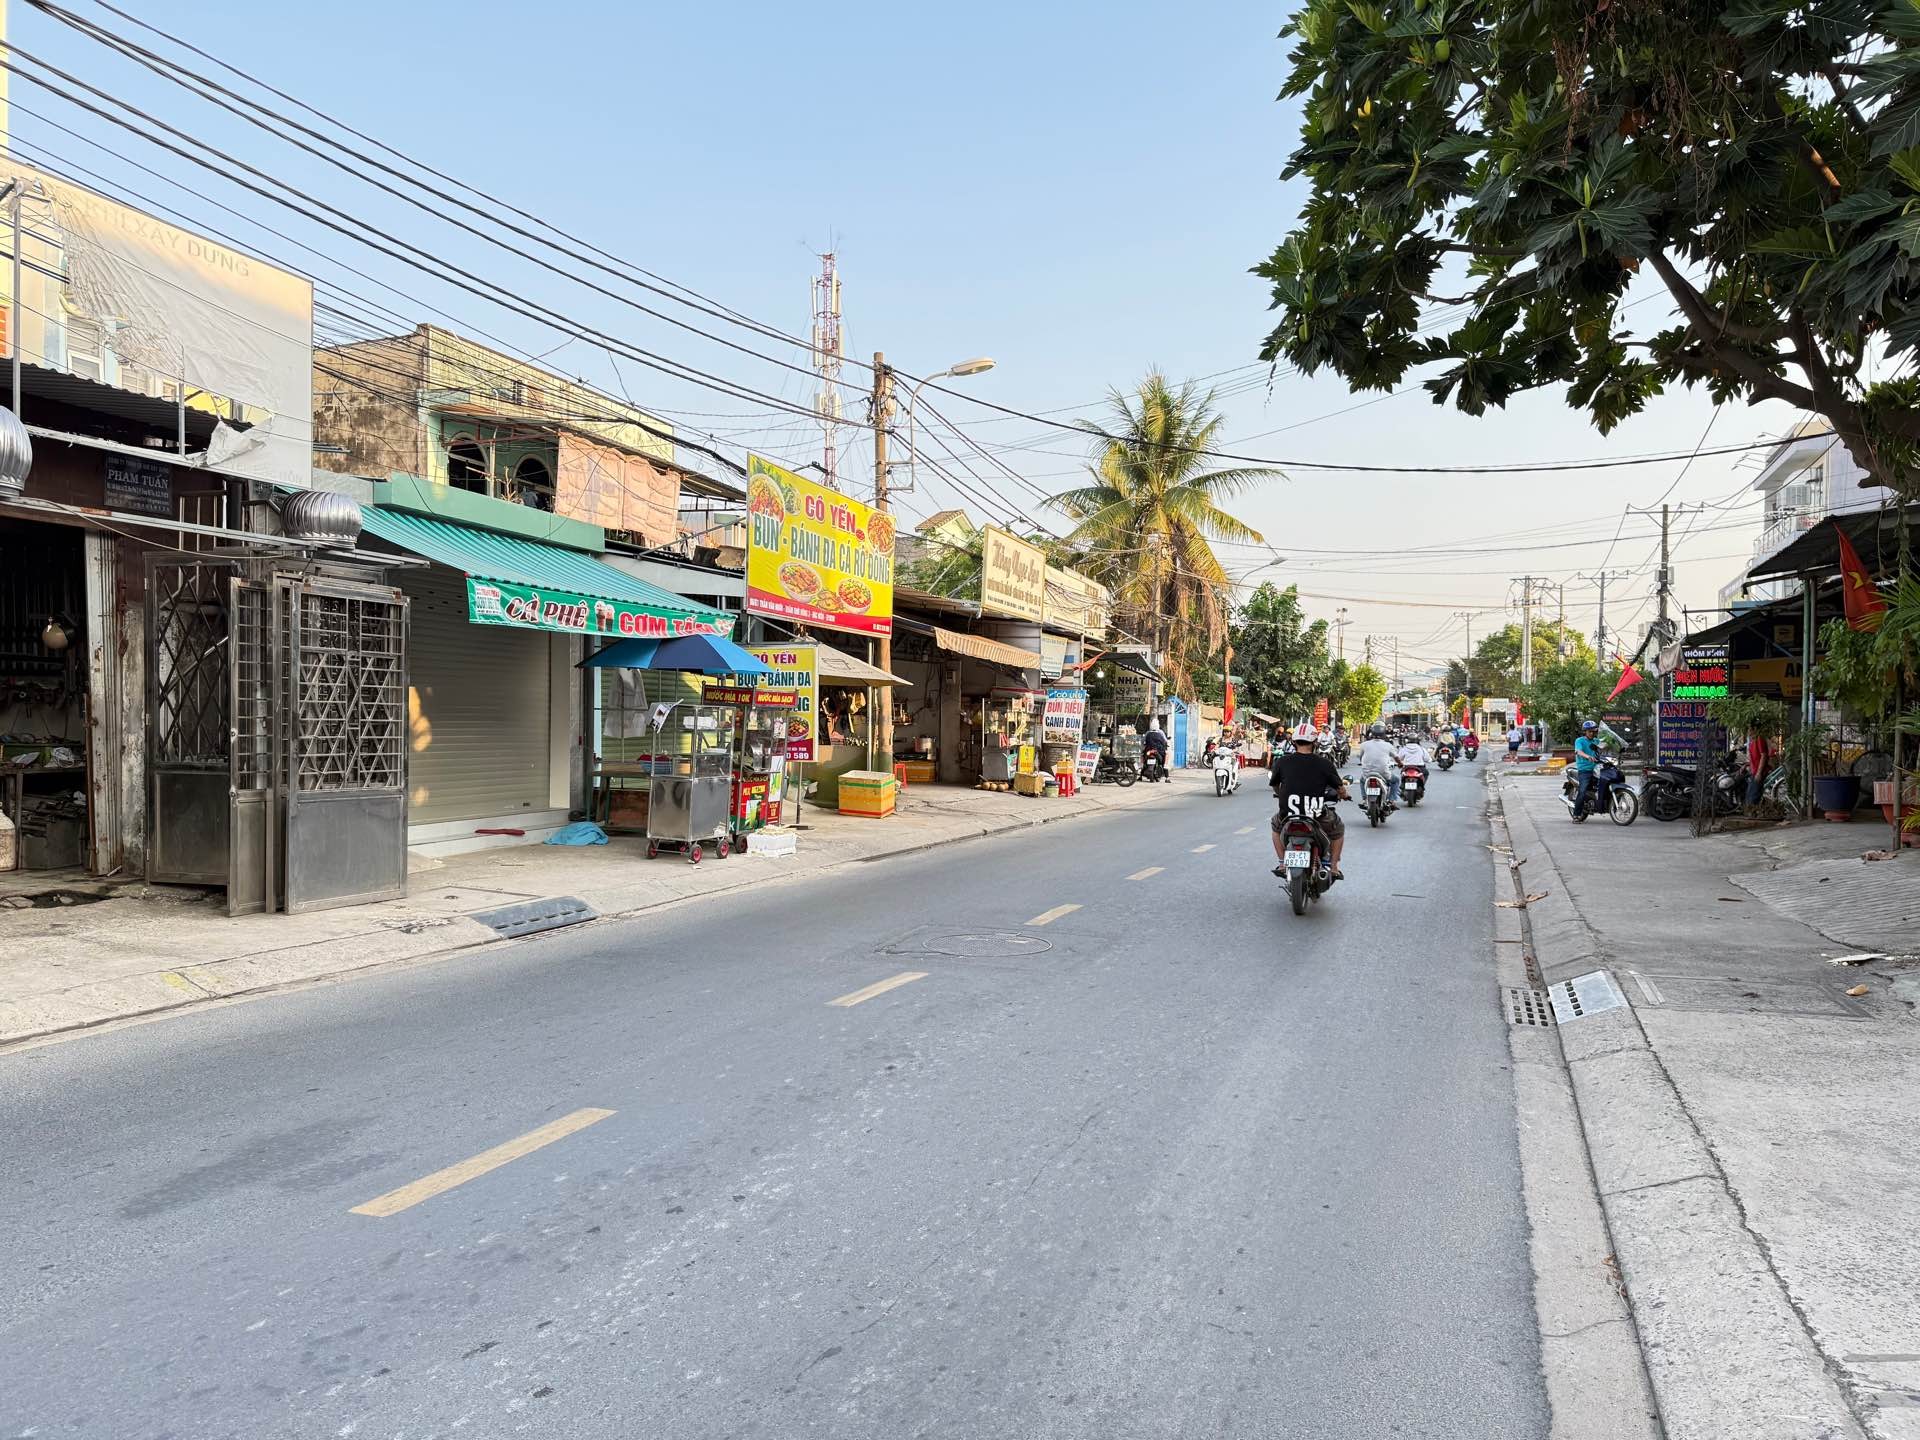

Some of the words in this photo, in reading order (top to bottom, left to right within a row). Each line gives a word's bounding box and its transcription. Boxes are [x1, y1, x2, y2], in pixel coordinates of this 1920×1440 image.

[805, 495, 825, 522] CÔ
[830, 504, 856, 534] YẾN
[753, 509, 779, 552] BÚN
[791, 522, 820, 565] BÁNH
[823, 538, 836, 569] ĐA
[839, 540, 851, 574] CÁ
[505, 592, 539, 623] CÀ
[542, 600, 589, 629] PHÊ
[619, 611, 668, 637] CƠM
[773, 650, 797, 664] YẾN
[768, 668, 795, 686] BÁNH
[797, 671, 811, 686] ĐA
[1047, 699, 1063, 713] BÚN
[1660, 703, 1692, 717] ANH
[1045, 716, 1064, 728] CANH
[1065, 716, 1081, 729] BÚN
[793, 752, 810, 760] 589
[1660, 750, 1675, 758] PHỤ
